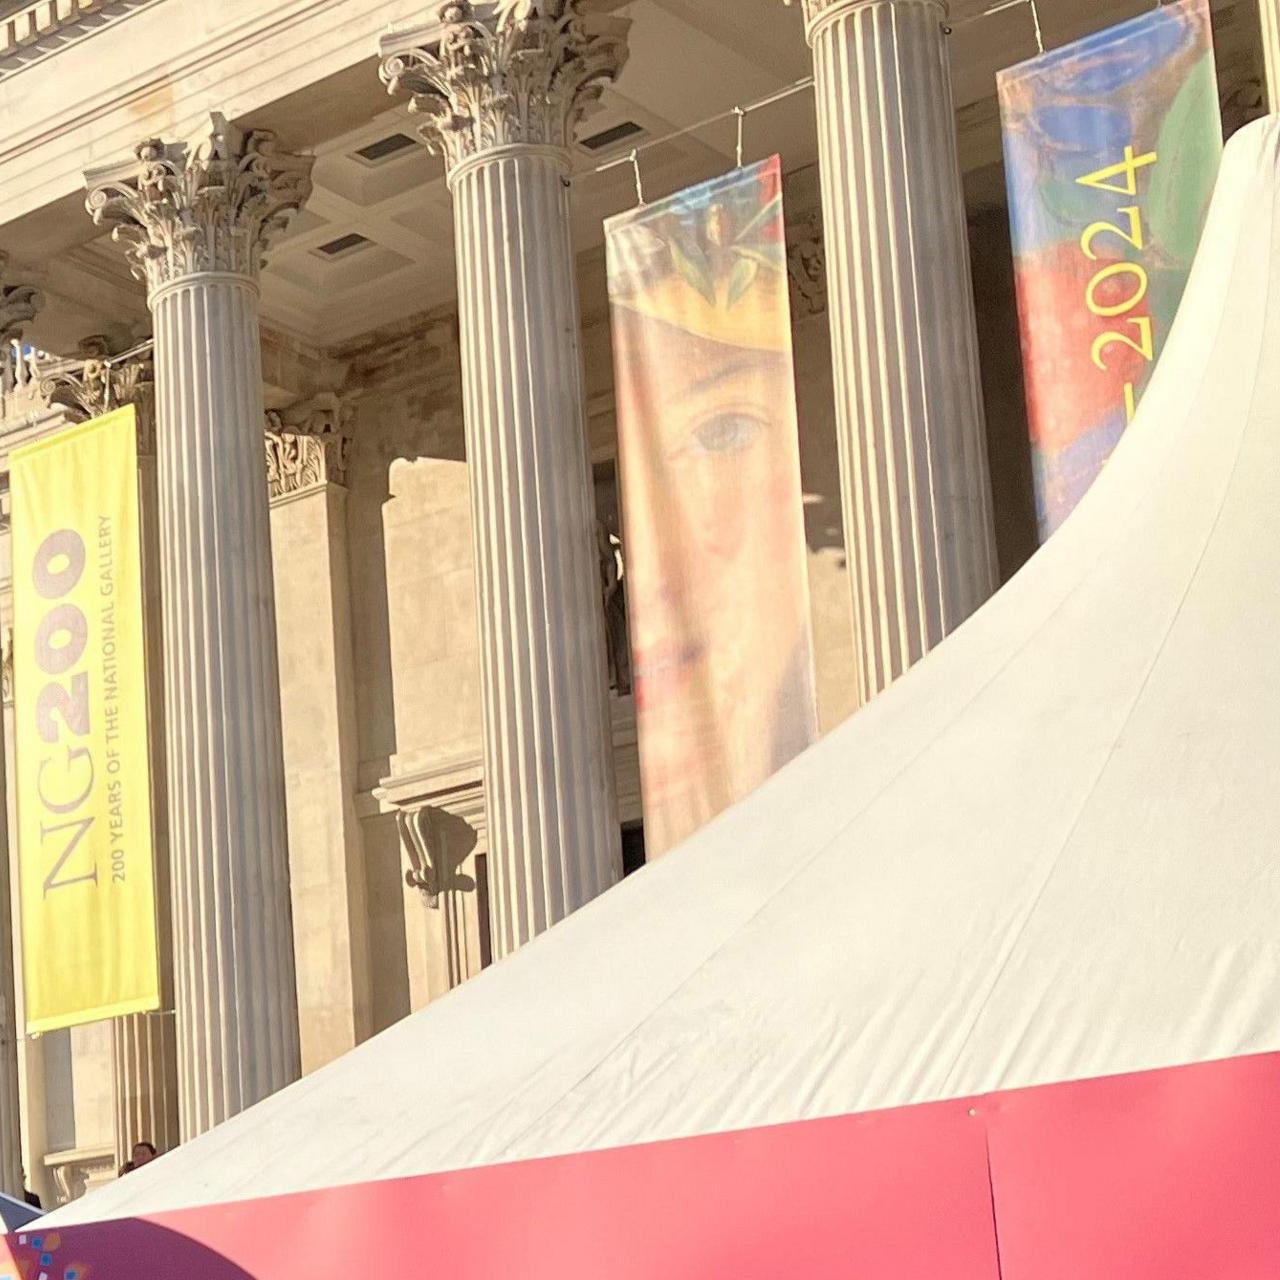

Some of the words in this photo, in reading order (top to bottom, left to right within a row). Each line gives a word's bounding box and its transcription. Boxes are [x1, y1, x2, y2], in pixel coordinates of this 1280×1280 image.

[1075, 145, 1158, 371] 2024
[98, 515, 114, 597] GALLERY
[101, 601, 119, 701] NATIONAL
[32, 528, 99, 900] NG200
[104, 705, 119, 744] THE
[106, 749, 121, 774] OF
[107, 780, 124, 844] YEARS
[111, 849, 125, 884] 200
